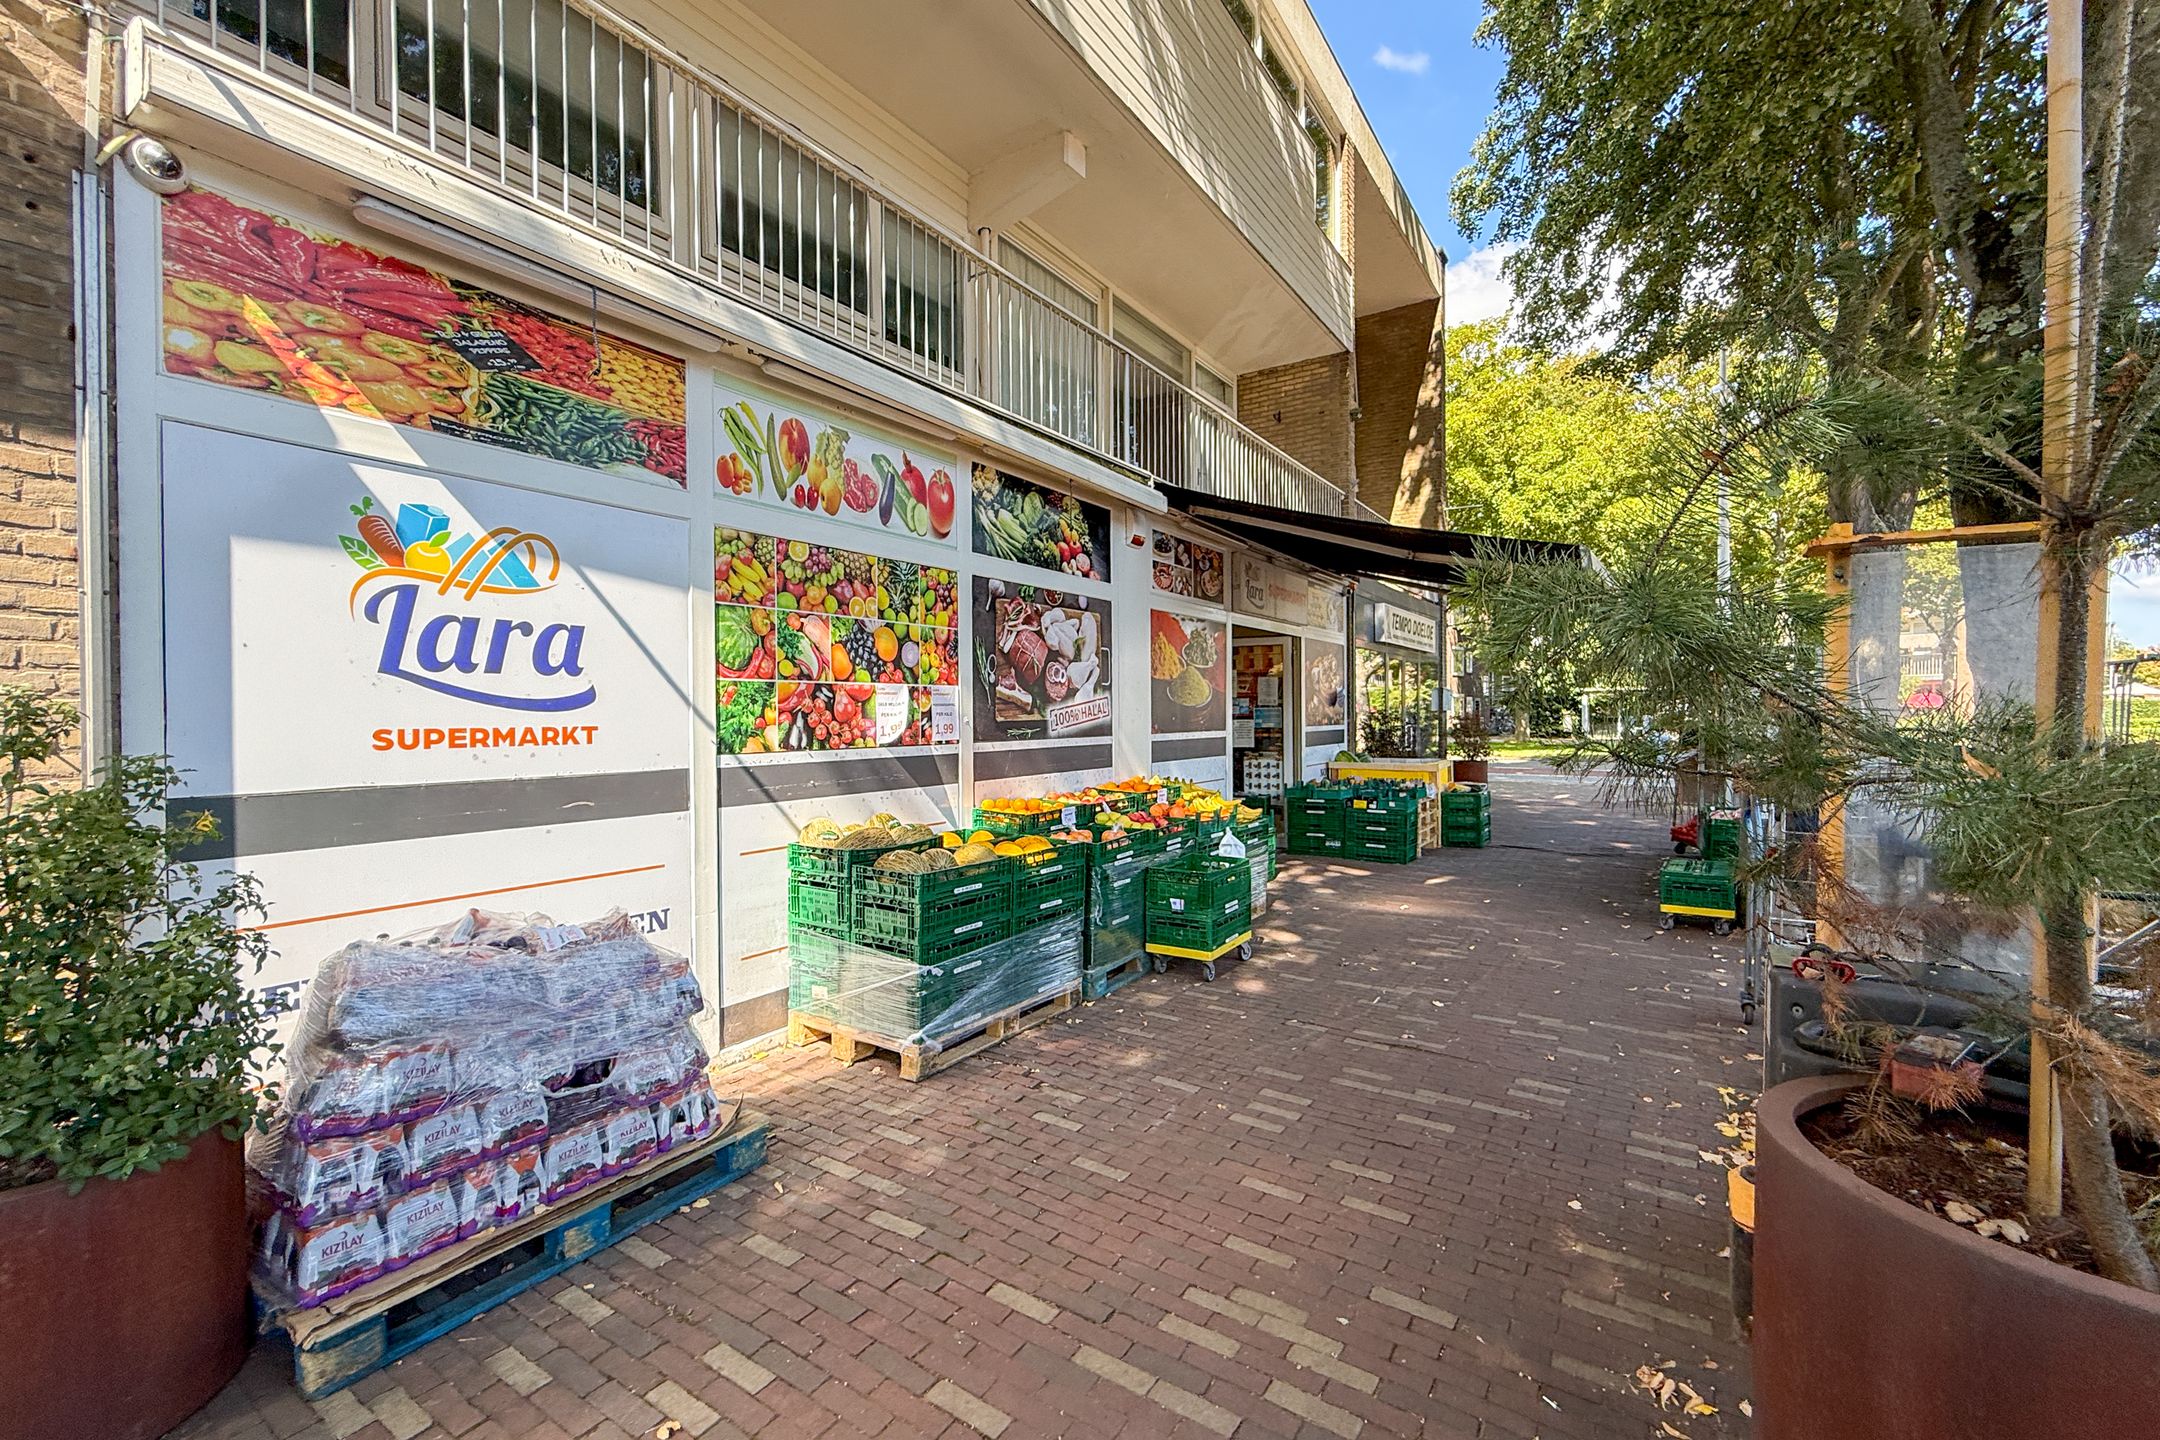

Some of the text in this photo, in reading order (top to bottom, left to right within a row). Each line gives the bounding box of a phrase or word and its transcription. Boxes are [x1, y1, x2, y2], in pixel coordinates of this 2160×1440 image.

[1392, 613, 1412, 634] TEMPO
[364, 584, 597, 712] Lara
[1054, 701, 1107, 727] 100% HALAL
[371, 726, 599, 751] SUPERMARKT
[935, 722, 954, 736] 1,99
[321, 1233, 365, 1259] KIZILAY
